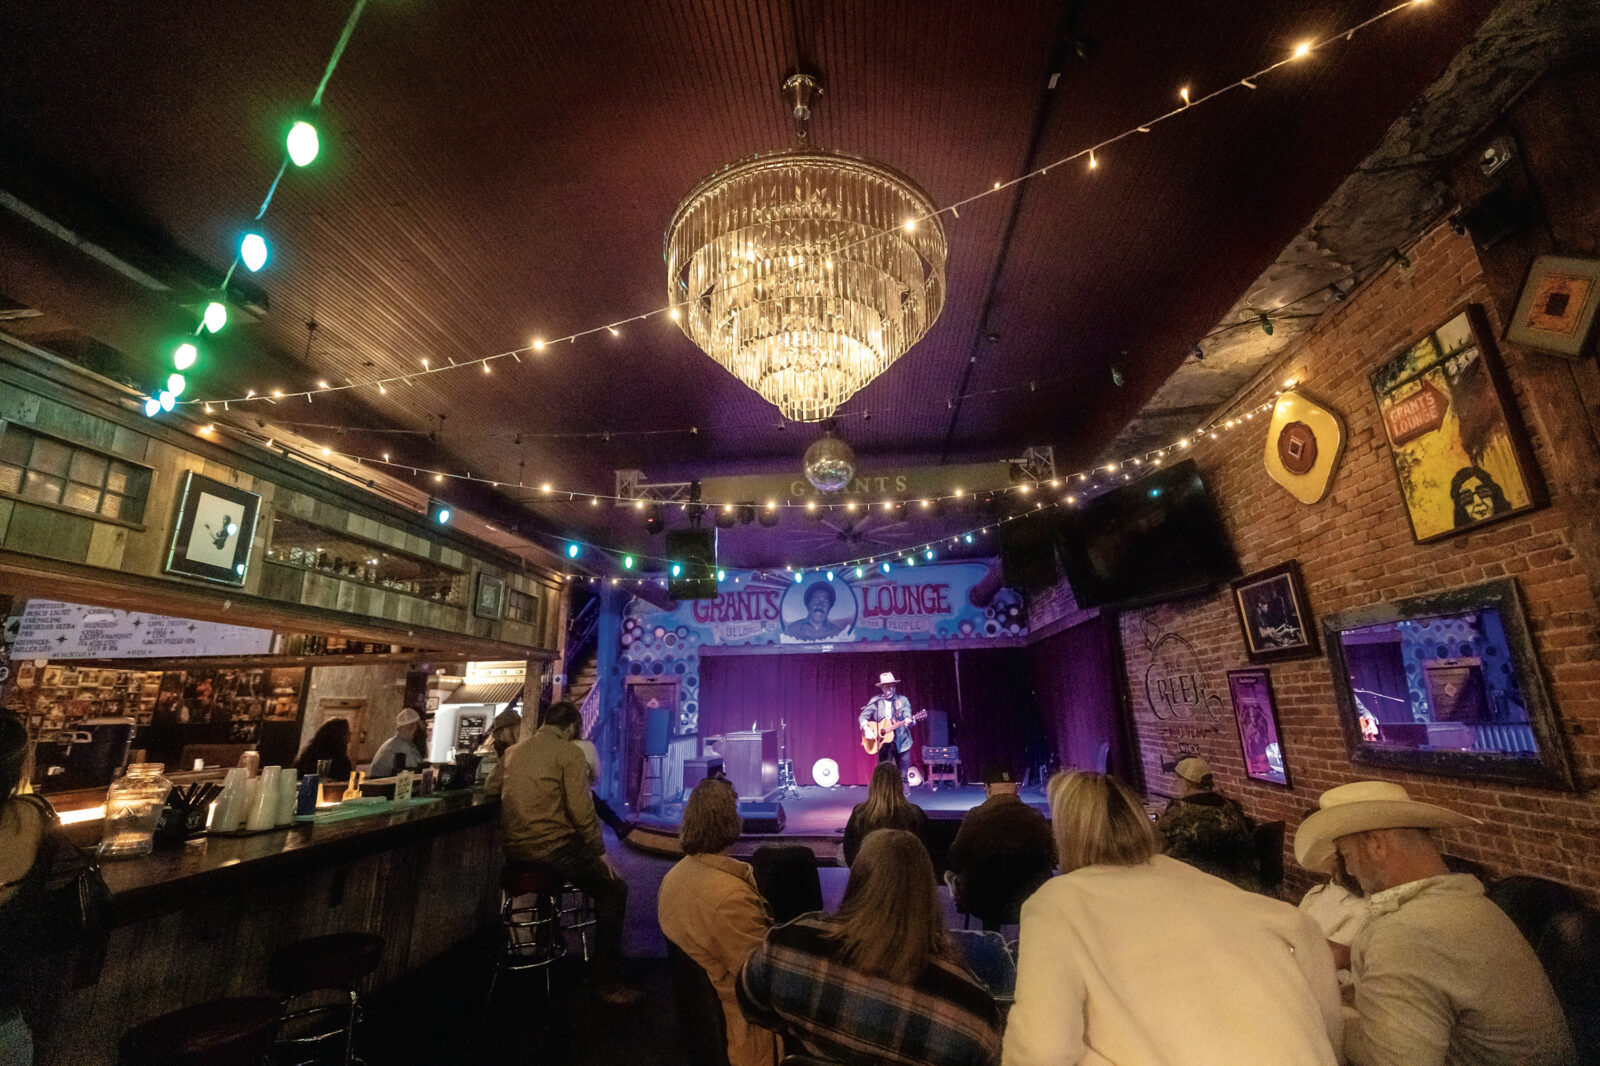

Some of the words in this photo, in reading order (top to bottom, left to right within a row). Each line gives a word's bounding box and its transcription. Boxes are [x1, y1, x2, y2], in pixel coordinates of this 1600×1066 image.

[1393, 405, 1439, 437] LOUNGE
[791, 475, 907, 496] GNTS
[861, 584, 951, 618] LOUNGE
[888, 621, 921, 630] PEOPLE
